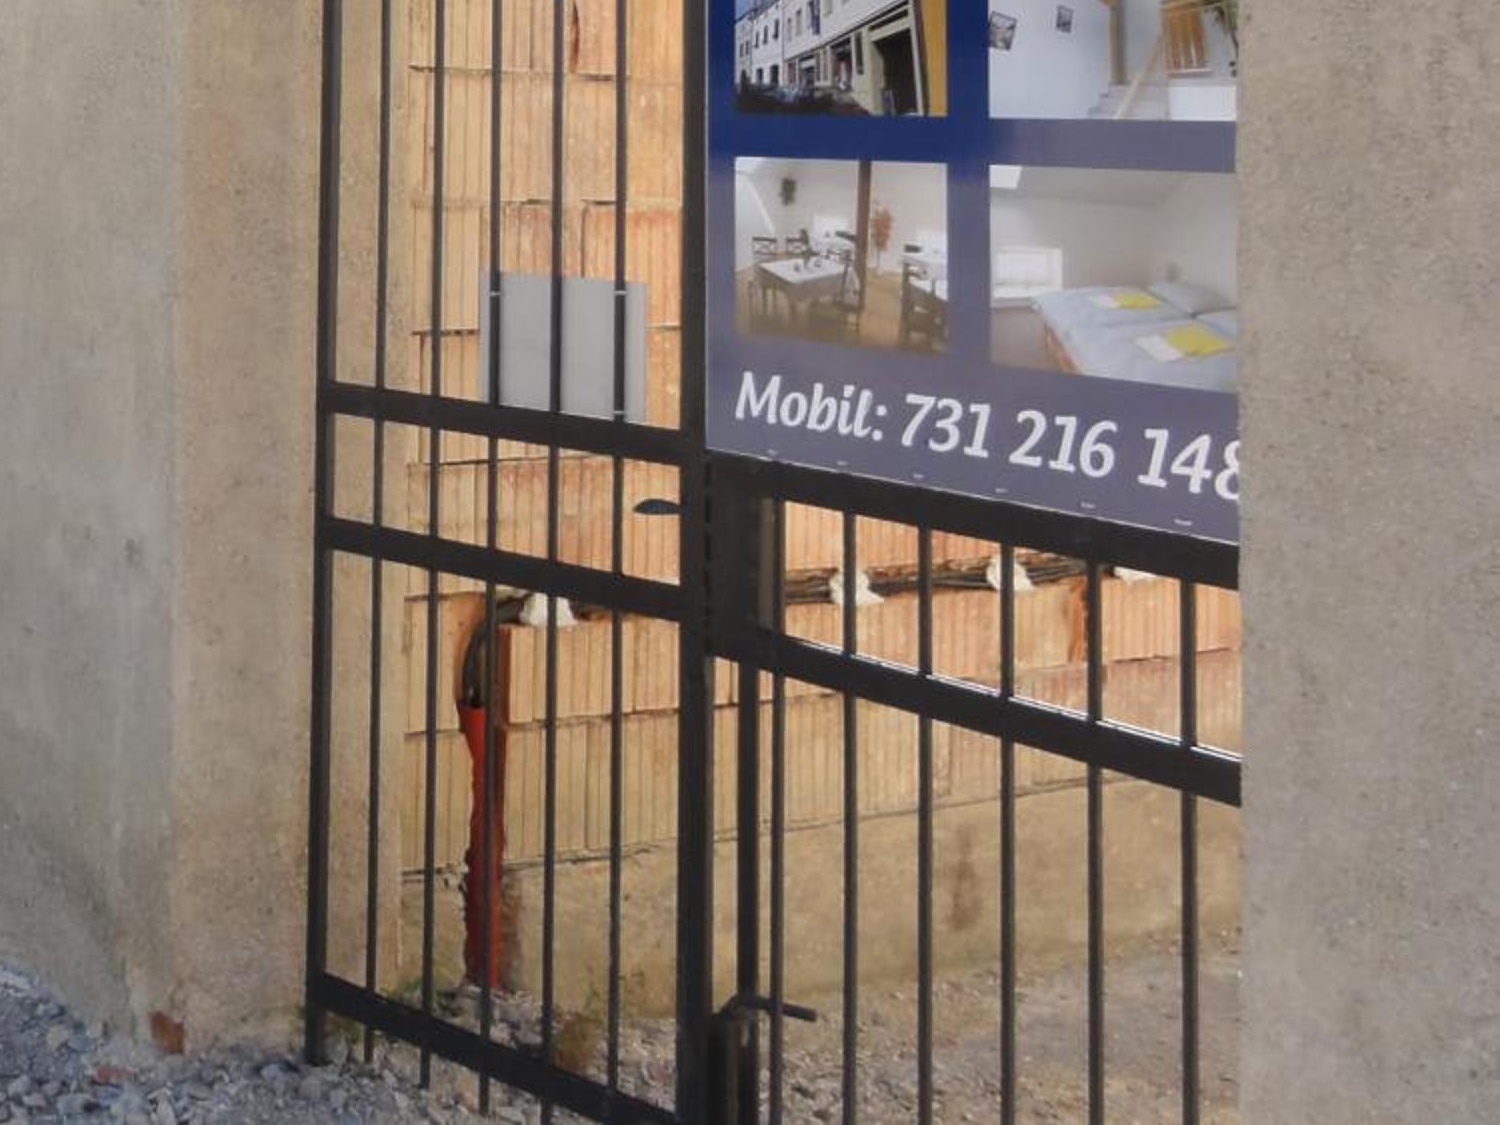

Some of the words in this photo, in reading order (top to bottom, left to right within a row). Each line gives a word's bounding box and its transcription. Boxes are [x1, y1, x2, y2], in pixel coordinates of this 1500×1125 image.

[735, 371, 888, 441] Mobil:
[900, 393, 992, 459] 731
[1008, 410, 1119, 477] 216
